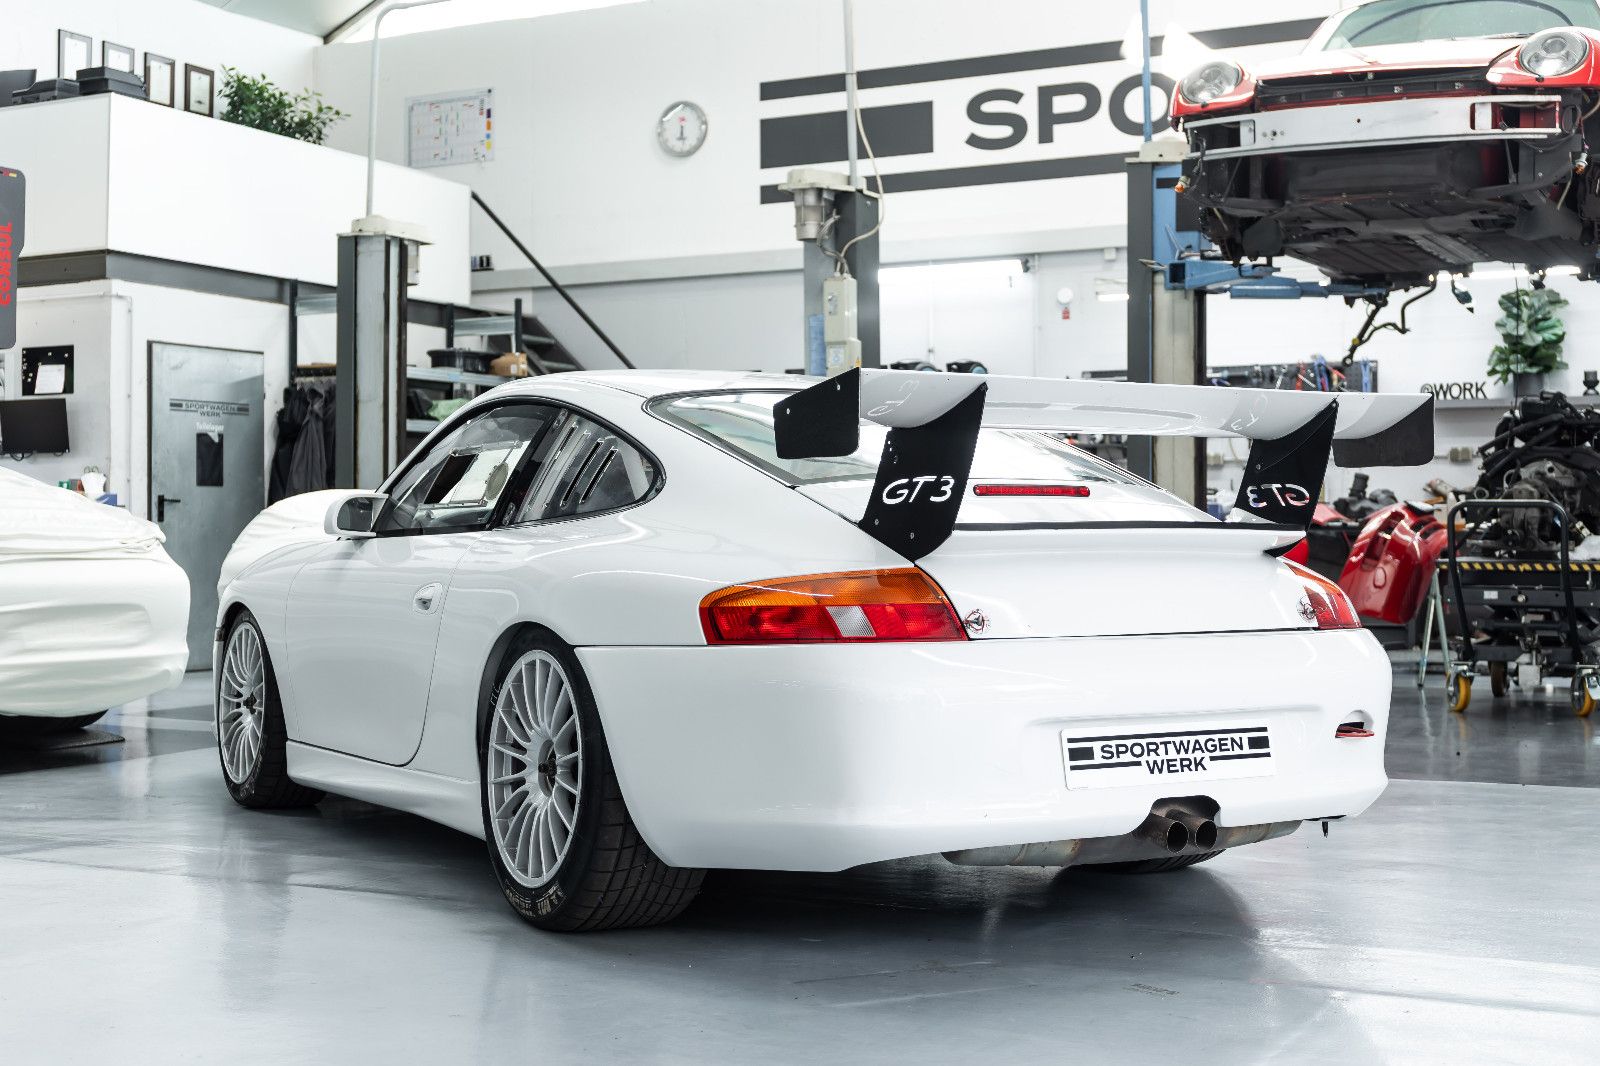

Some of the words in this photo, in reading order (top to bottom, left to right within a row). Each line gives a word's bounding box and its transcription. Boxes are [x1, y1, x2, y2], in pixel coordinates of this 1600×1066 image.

[185, 402, 236, 412] SPORTWAGEN
[882, 475, 955, 505] GT3
[1100, 736, 1244, 760] SPORTWAGEN
[1145, 756, 1207, 775] WERK
